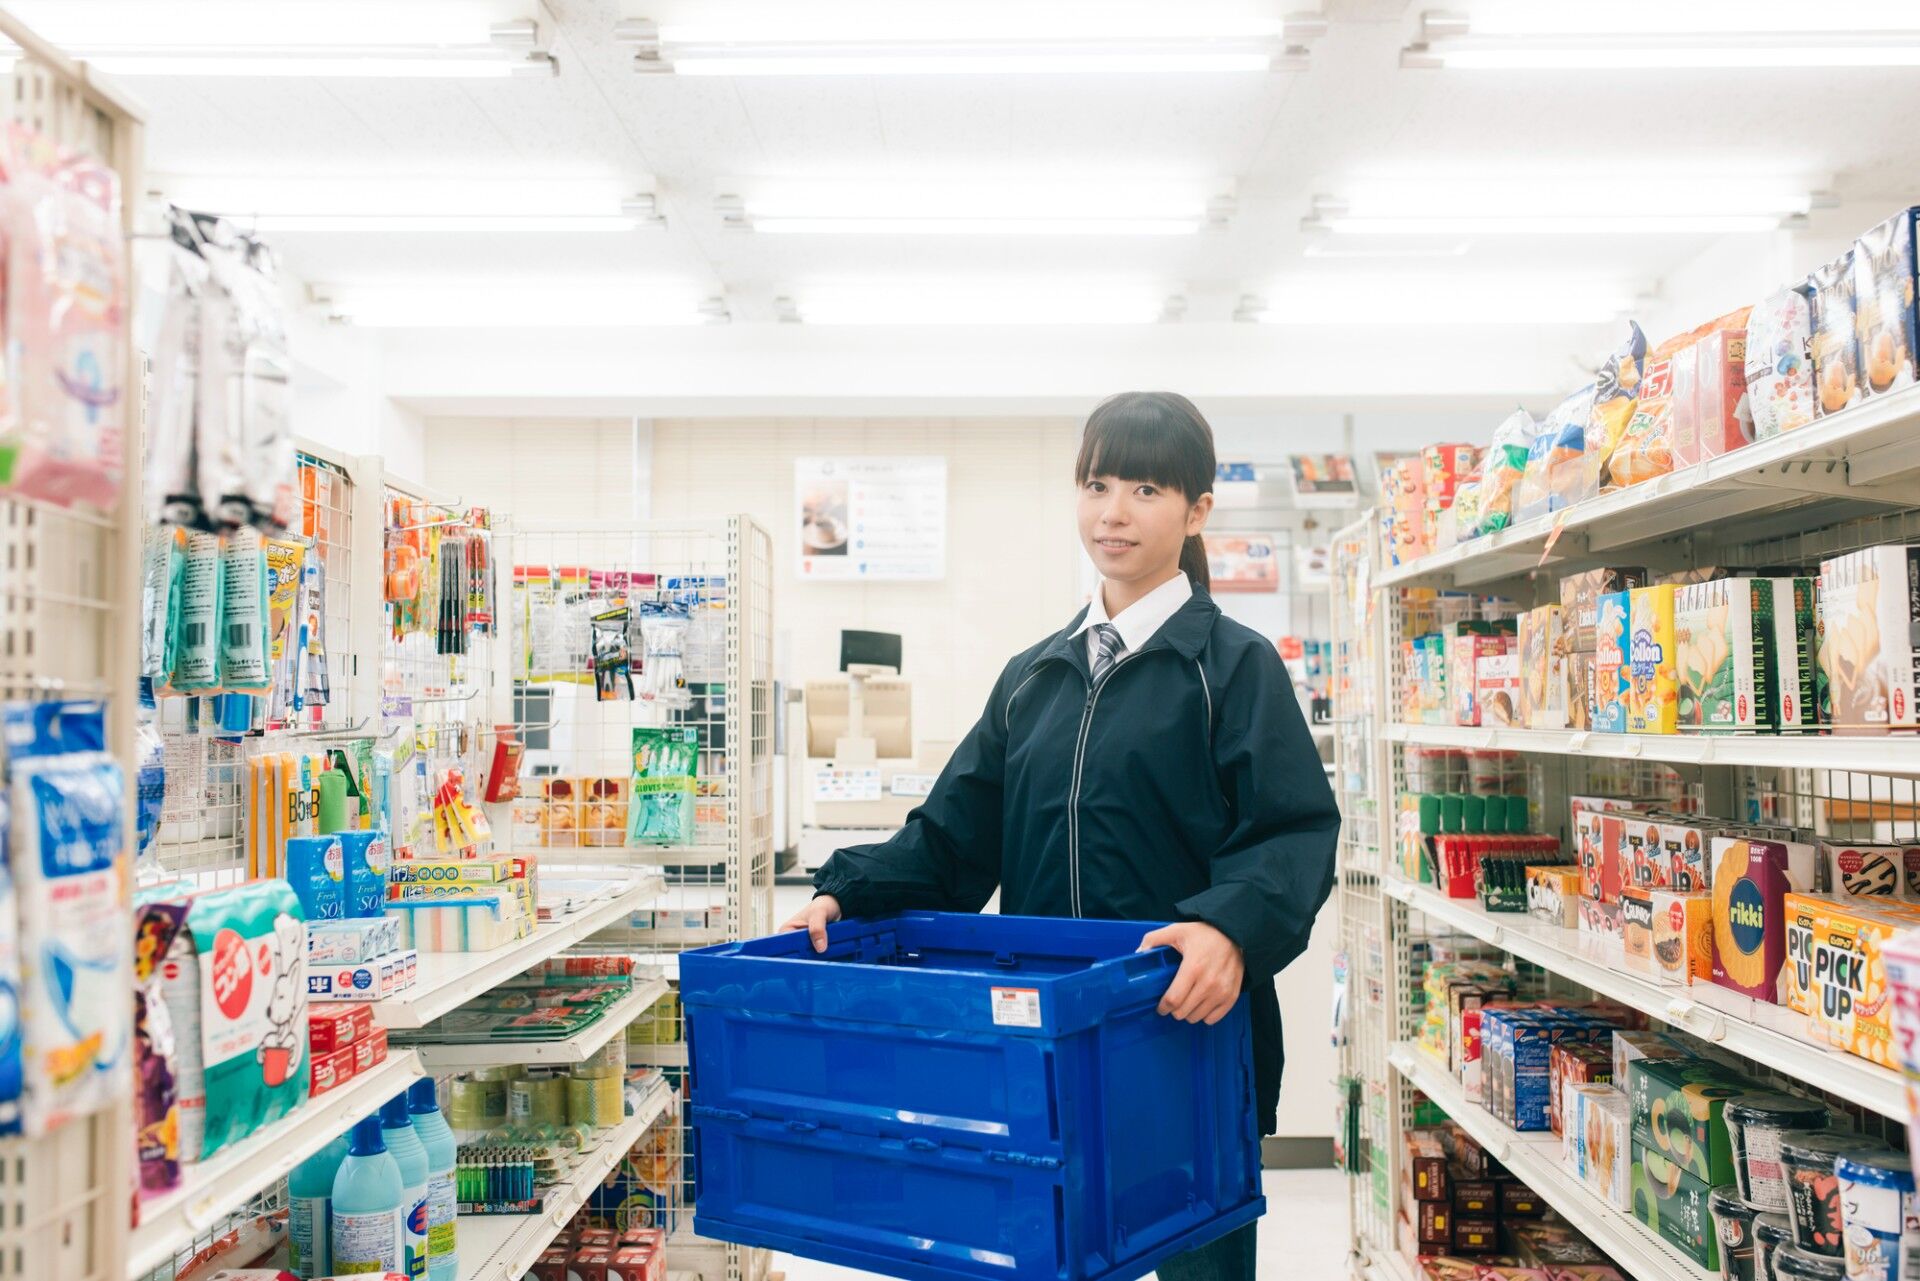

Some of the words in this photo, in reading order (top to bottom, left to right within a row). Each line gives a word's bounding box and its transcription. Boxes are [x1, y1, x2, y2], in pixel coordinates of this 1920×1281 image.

[316, 891, 337, 901] Fresh
[356, 884, 377, 894] Fresh
[1730, 901, 1763, 928] rikki
[1815, 947, 1865, 992] PICK
[1824, 983, 1852, 1021] UP
